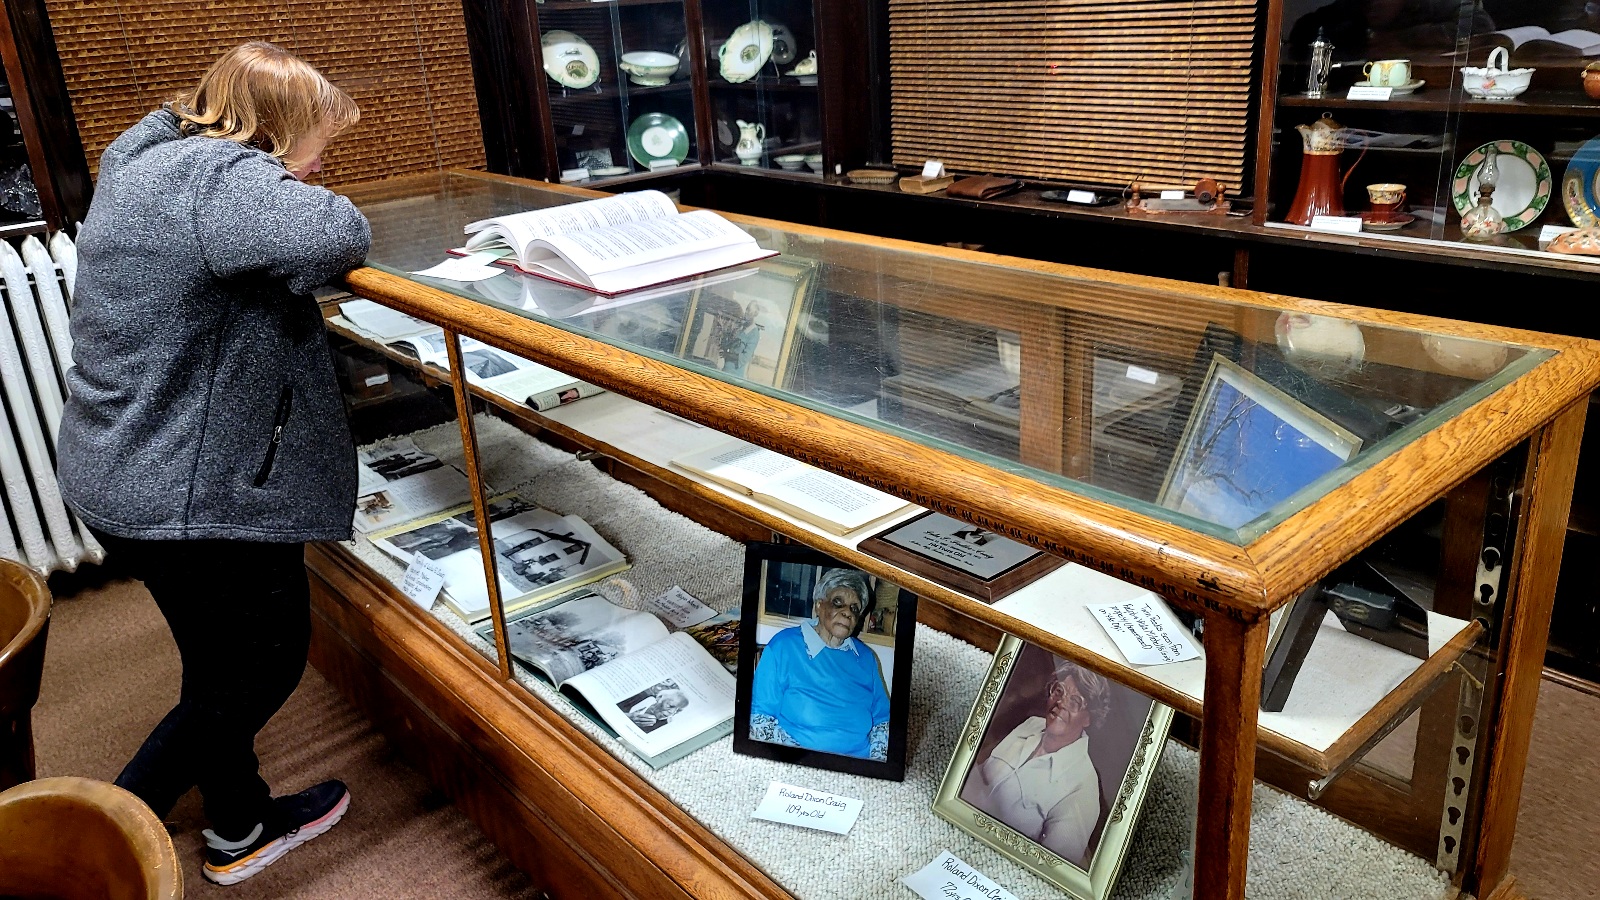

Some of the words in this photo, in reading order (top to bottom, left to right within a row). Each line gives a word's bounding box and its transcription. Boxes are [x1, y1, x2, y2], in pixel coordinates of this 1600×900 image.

[779, 788, 805, 800] Roland
[804, 792, 824, 804] Dixon
[825, 796, 847, 811] Craig
[810, 810, 826, 818] Old
[942, 857, 973, 880] Roland
[966, 875, 989, 895] Dixon
